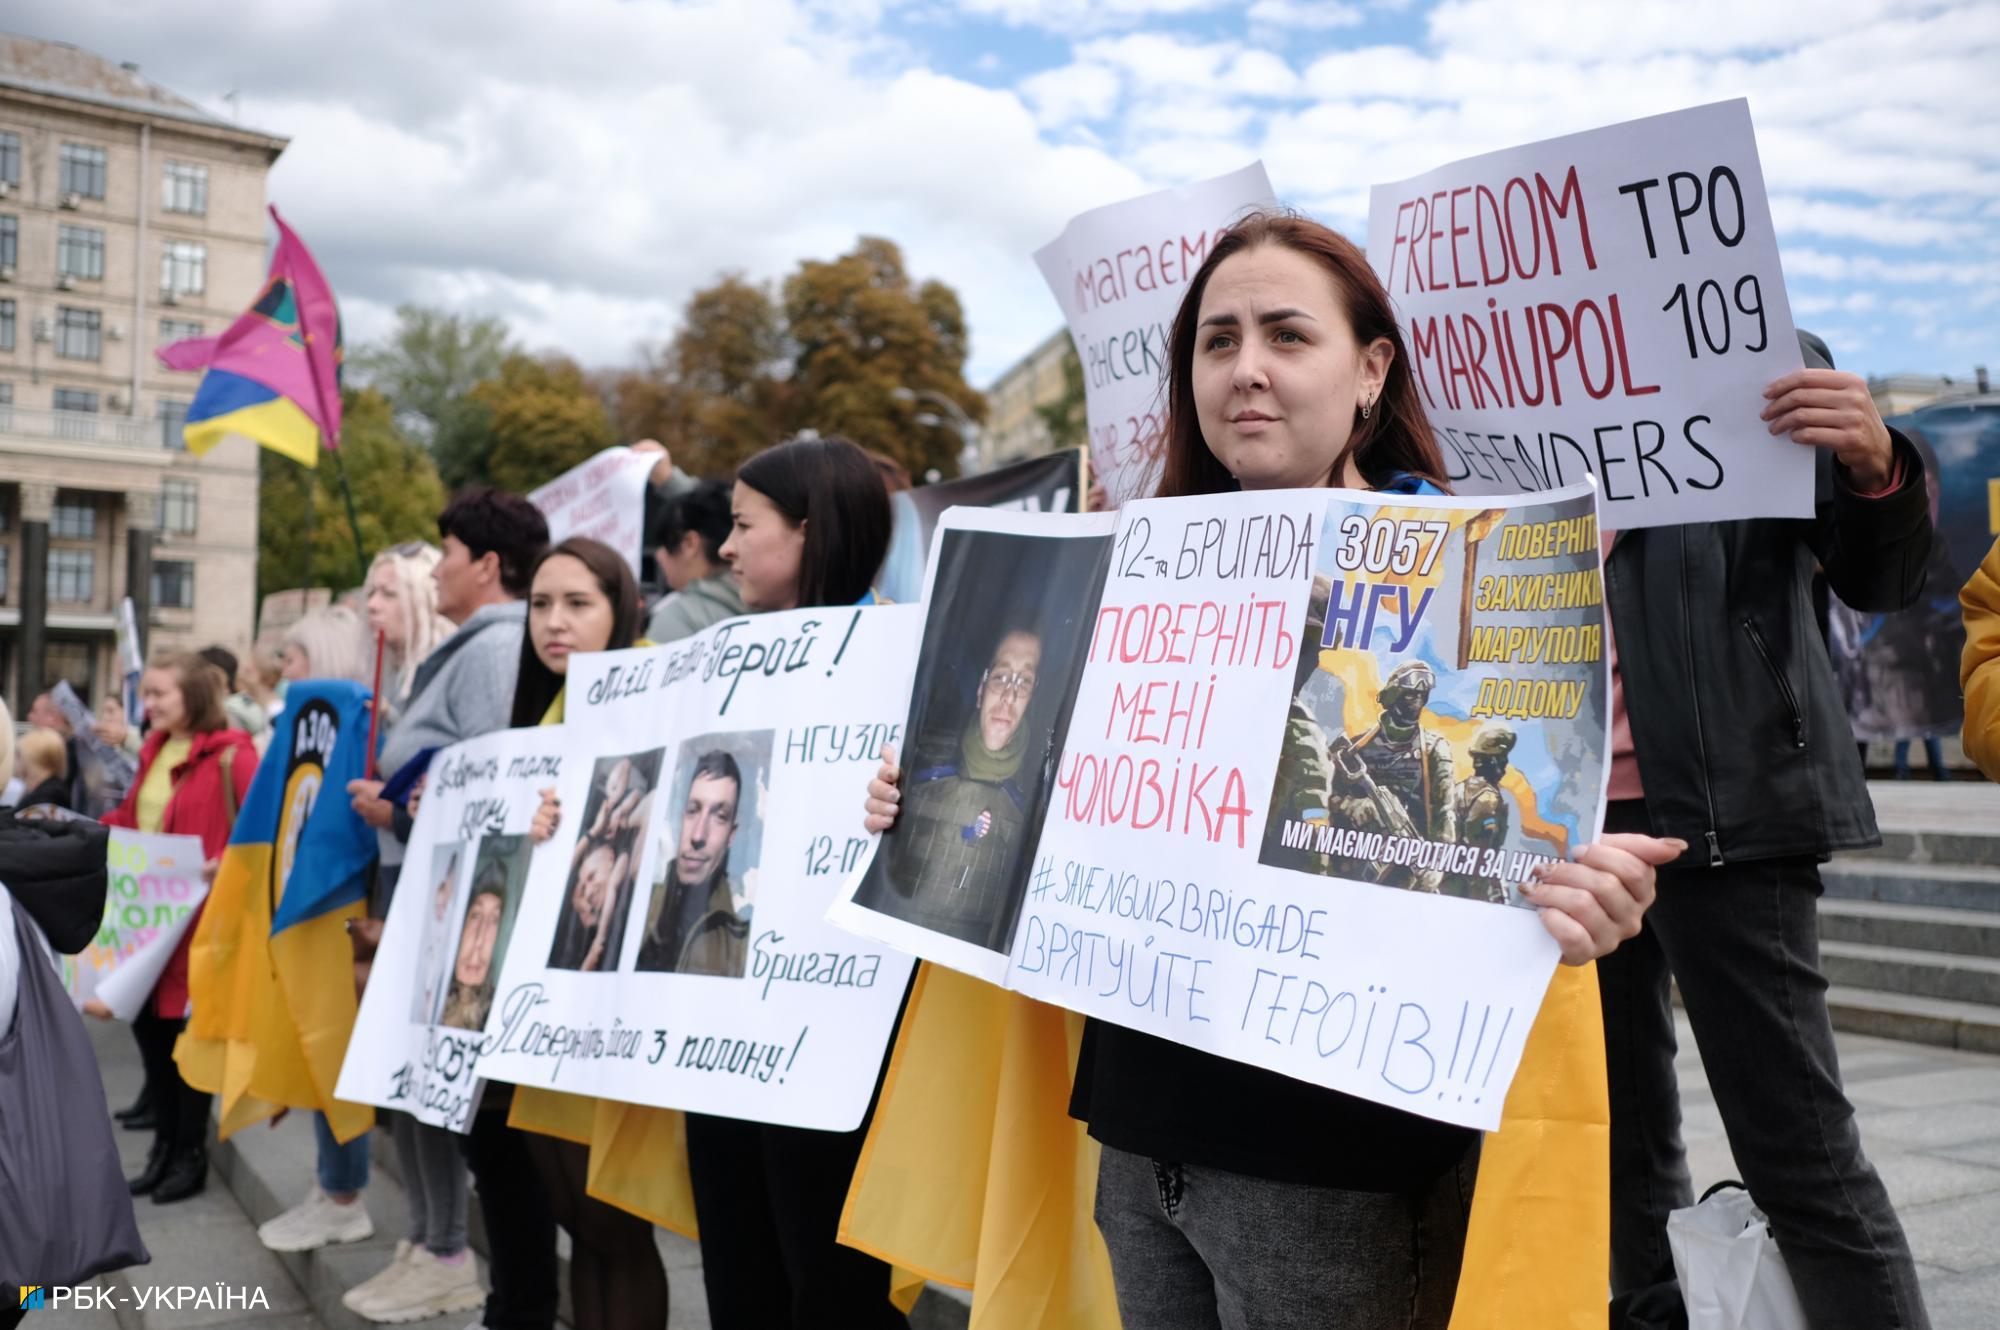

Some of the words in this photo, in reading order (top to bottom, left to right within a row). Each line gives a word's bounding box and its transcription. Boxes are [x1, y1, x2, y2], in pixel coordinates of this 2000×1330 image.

[1387, 165, 1597, 295] FREEDOM
[1662, 274, 1769, 360] 109
[1174, 512, 1315, 581] БРИГАДА
[1335, 514, 1450, 577] 3057
[1497, 512, 1599, 561] ПОВЕРНІТ
[1320, 578, 1436, 656] НГУ
[1467, 622, 1602, 664] МАРІУПОЛЯ
[1470, 677, 1587, 721] ДОДОМУ
[1280, 819, 1313, 850] МИ
[1315, 826, 1385, 865] МАЄМО
[1382, 836, 1480, 877] БОРОТИСЯ
[1479, 848, 1502, 879] ЗА
[752, 929, 882, 1001] бригада
[1017, 915, 1213, 1023] ВРЯТУЙТЕ
